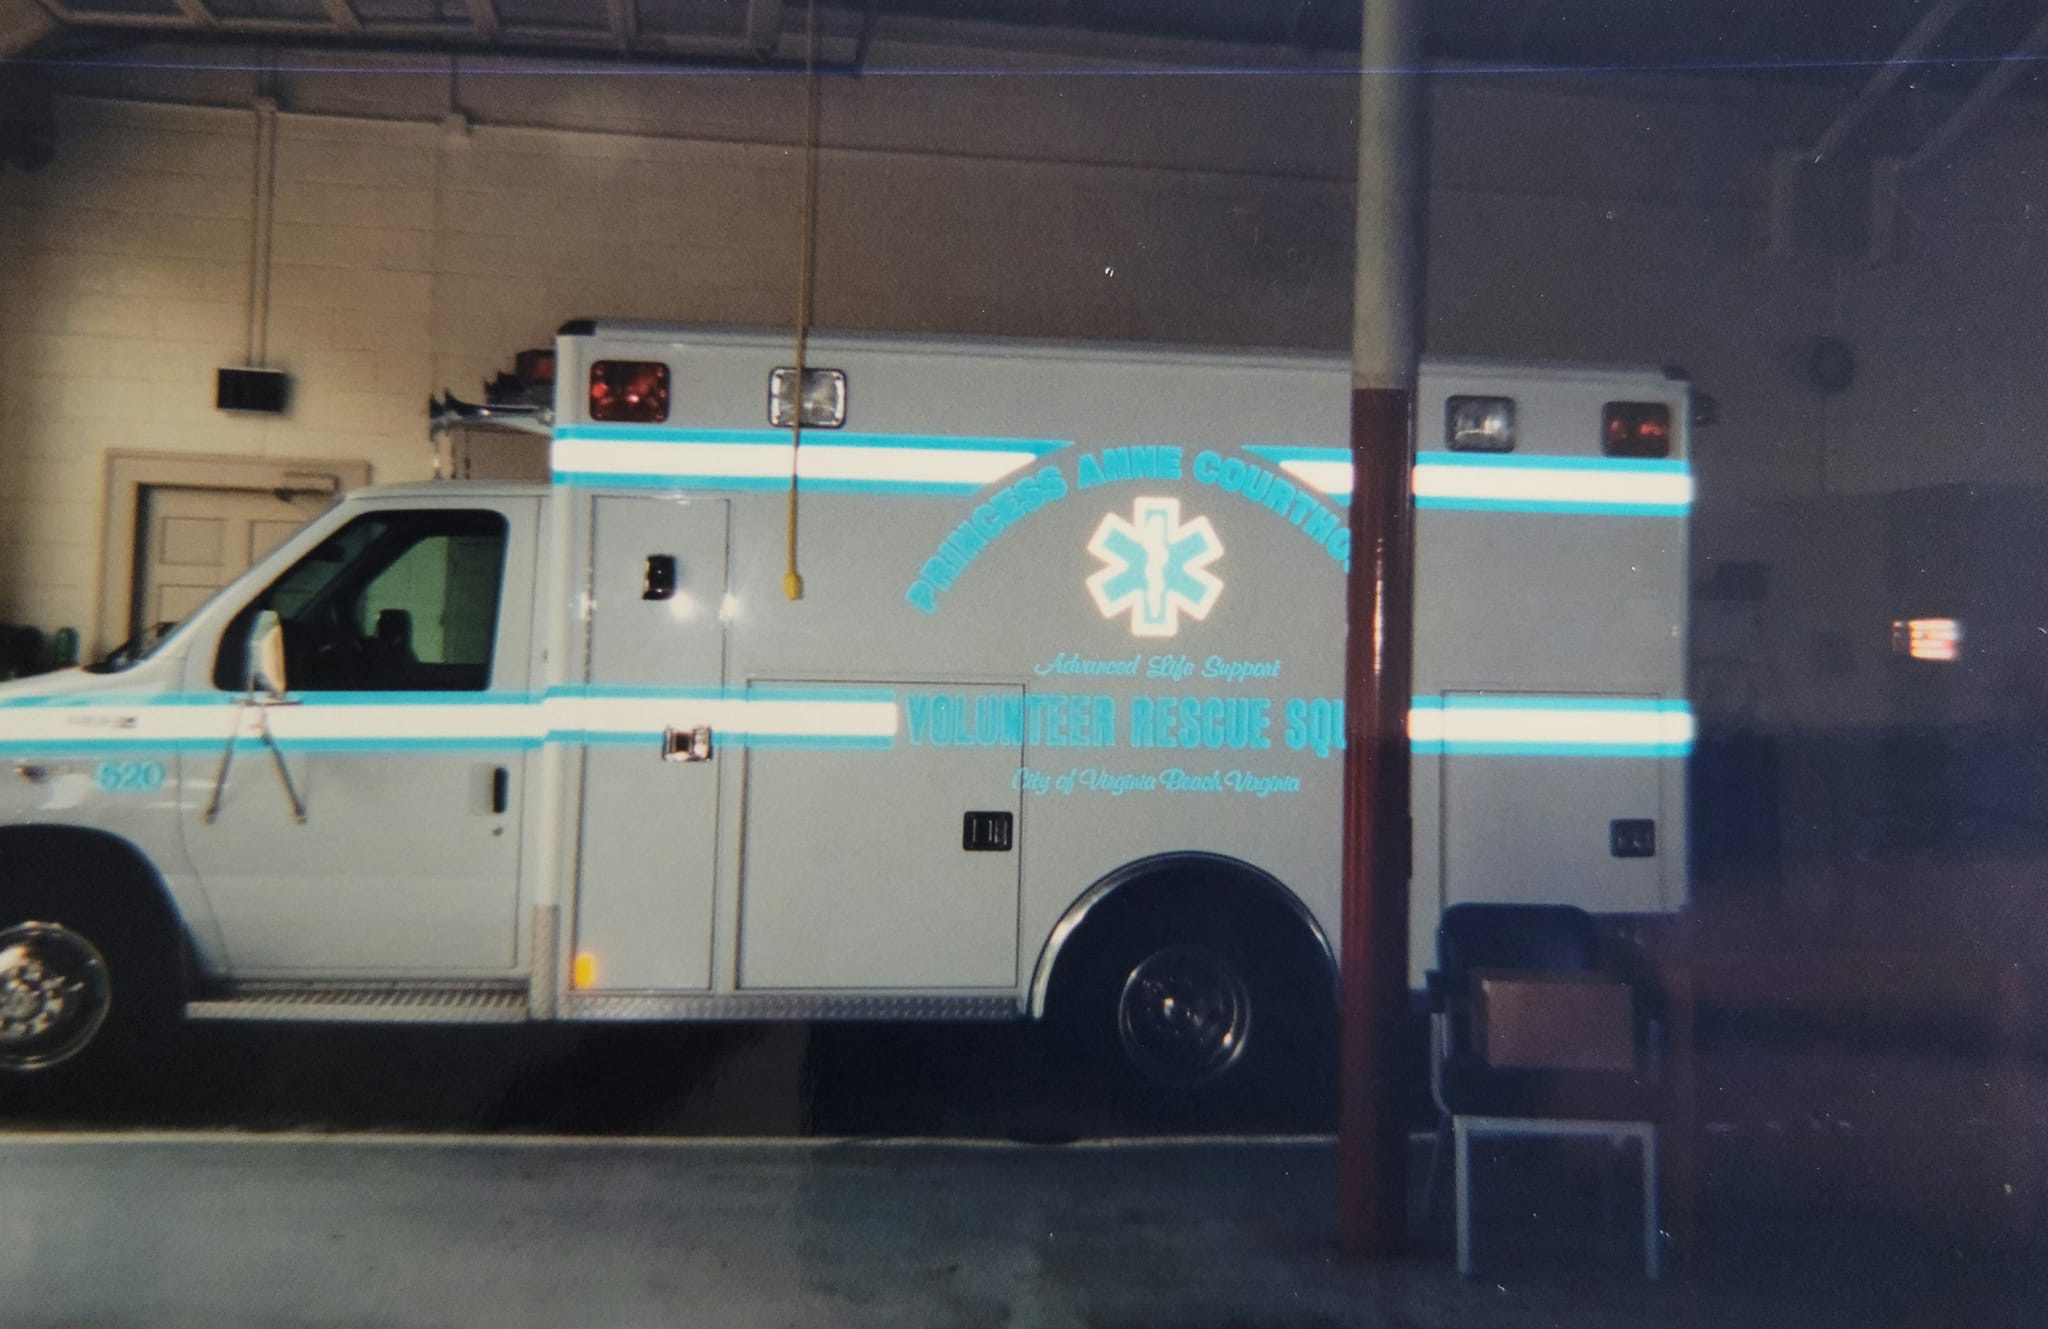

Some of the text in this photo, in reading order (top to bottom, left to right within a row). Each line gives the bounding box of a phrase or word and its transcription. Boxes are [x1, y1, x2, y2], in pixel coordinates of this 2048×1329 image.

[905, 445, 1351, 615] PRINCESS ANNE COURTHO
[1034, 652, 1281, 682] Advanced Life Support
[906, 694, 1116, 748] VOLUNTEER
[1131, 696, 1271, 750] RESCUE
[1012, 767, 1050, 795] City
[1056, 768, 1077, 794] of
[1079, 768, 1156, 796] Virginia
[1224, 770, 1299, 797] Virginia
